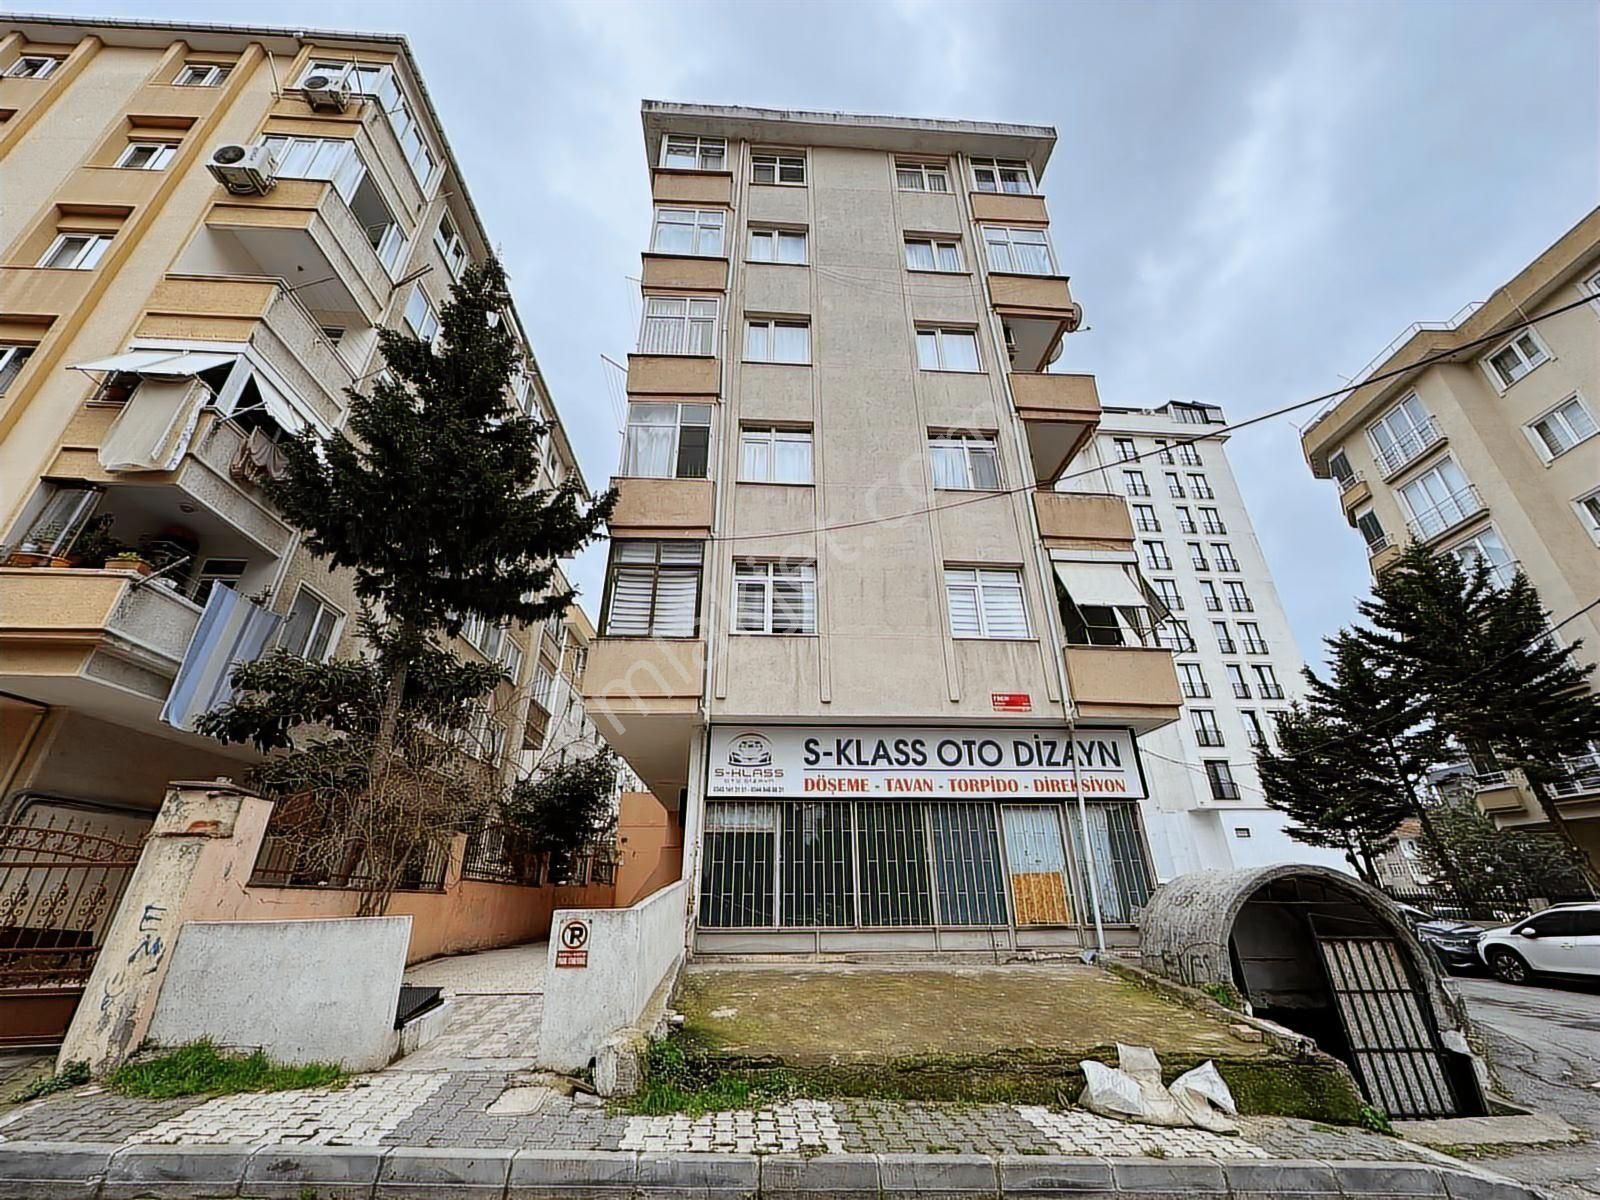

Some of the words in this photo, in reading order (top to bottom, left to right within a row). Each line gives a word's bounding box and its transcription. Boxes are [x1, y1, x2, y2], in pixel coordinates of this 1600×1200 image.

[803, 738, 928, 766] S-KLASS
[936, 739, 1004, 767] OTO
[1012, 734, 1122, 767] DİZAYN
[803, 775, 870, 795] DÖŞEME
[884, 777, 934, 793] TAVAN
[948, 776, 1019, 793] TORPİDO
